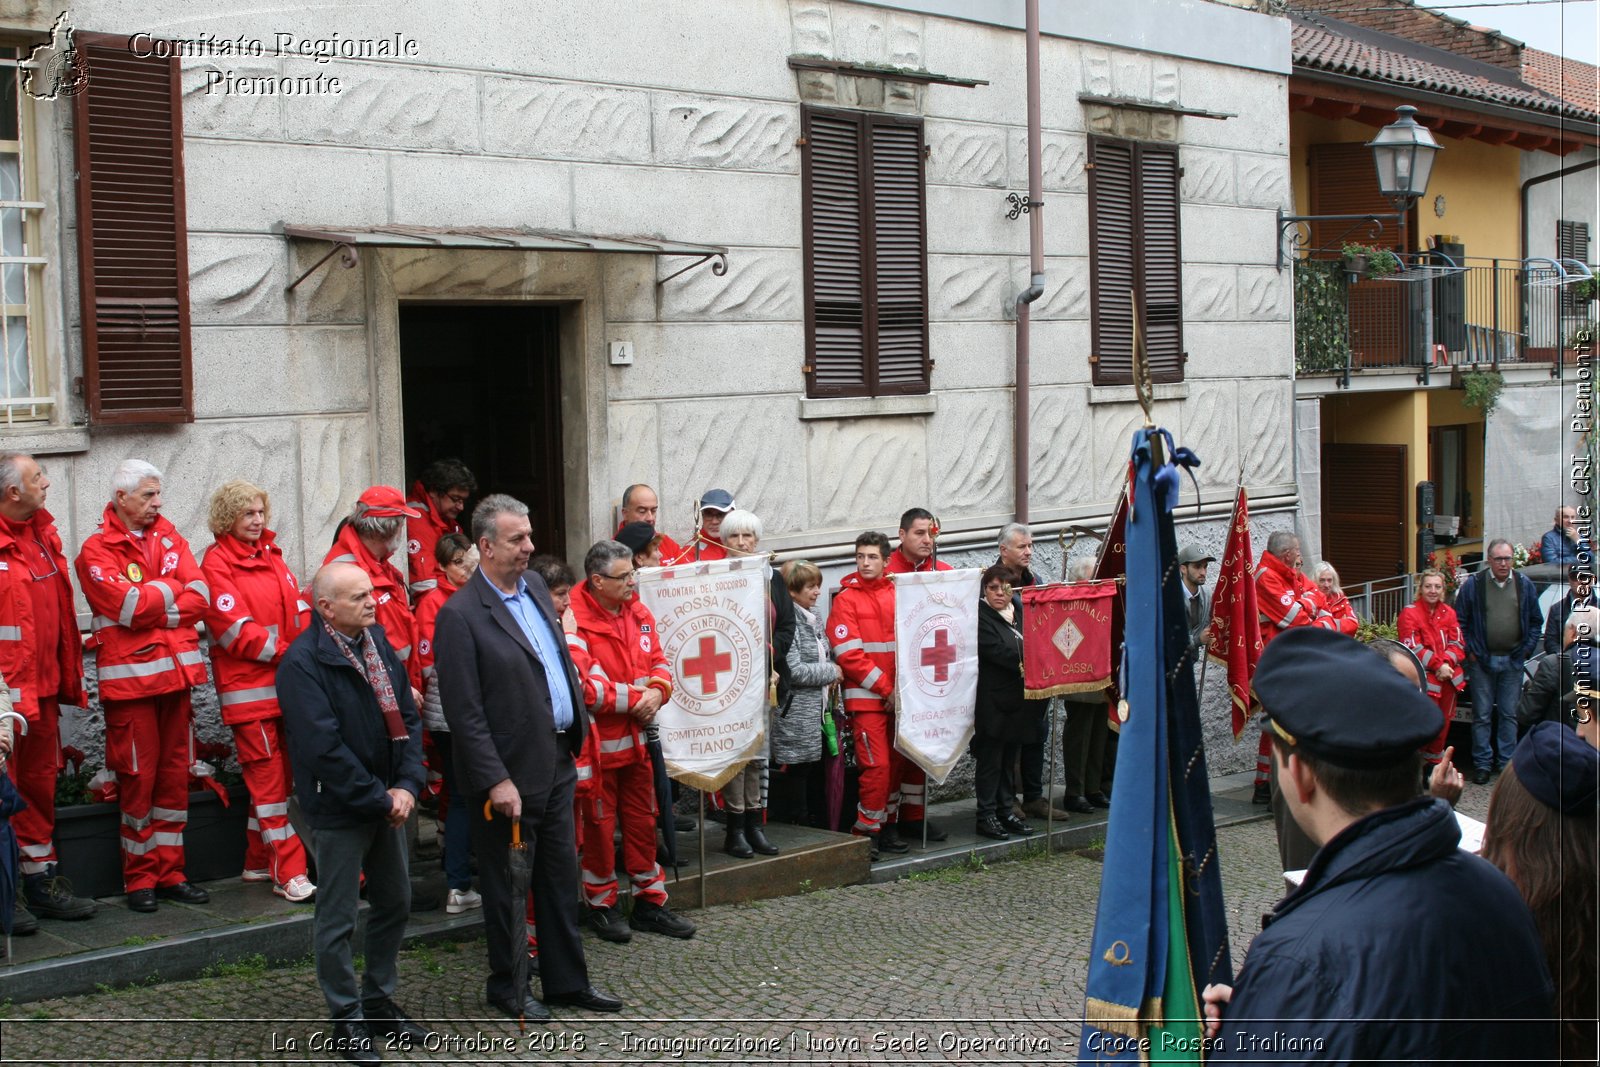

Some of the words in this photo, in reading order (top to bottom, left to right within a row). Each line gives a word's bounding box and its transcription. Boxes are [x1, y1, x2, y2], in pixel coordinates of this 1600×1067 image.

[618, 345, 627, 360] 4
[656, 586, 697, 598] VOLONTARI
[700, 583, 713, 594] DEL
[715, 578, 748, 592] SOCCORSO
[674, 595, 719, 620] ROSSA
[721, 597, 763, 647] ITALIANA
[690, 616, 731, 633] GINEVRA
[1031, 603, 1056, 632] AVIS
[1060, 599, 1109, 626] COMUNALE
[675, 628, 689, 642] DI
[731, 631, 745, 645] 22
[736, 646, 750, 687] AGOSTO
[1042, 665, 1056, 680] LA
[1061, 662, 1094, 675] CASSA
[667, 726, 715, 743] COMITATO
[718, 718, 754, 735] LOCALE
[690, 737, 735, 756] FIANO
